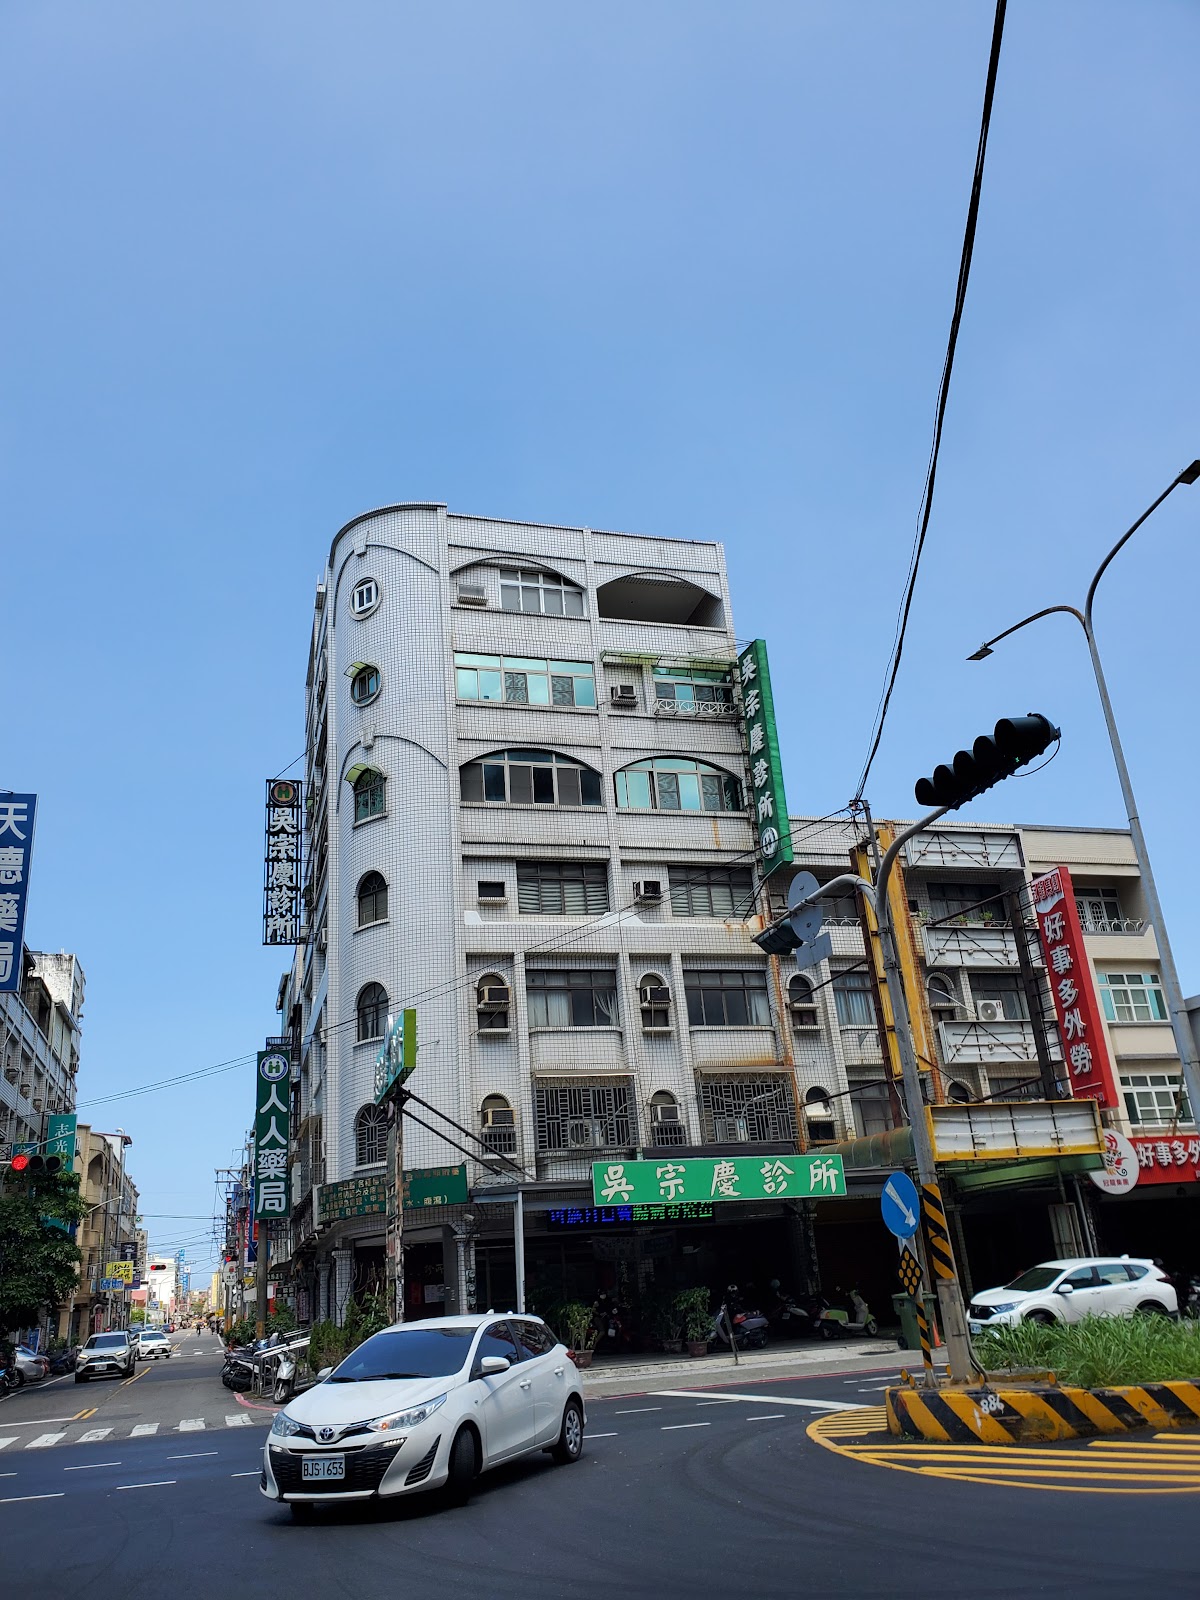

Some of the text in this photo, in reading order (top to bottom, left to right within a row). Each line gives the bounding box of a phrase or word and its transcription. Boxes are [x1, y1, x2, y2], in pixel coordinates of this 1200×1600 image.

[741, 654, 774, 824] 吳宗慶診所
[267, 807, 298, 940] 吳宗慶診所
[1043, 910, 1094, 1077] 好事多外勞
[257, 1083, 288, 1214] 人人藥局
[601, 1159, 839, 1202] 吳宗慶診所
[303, 1461, 344, 1477] BJS-1653
